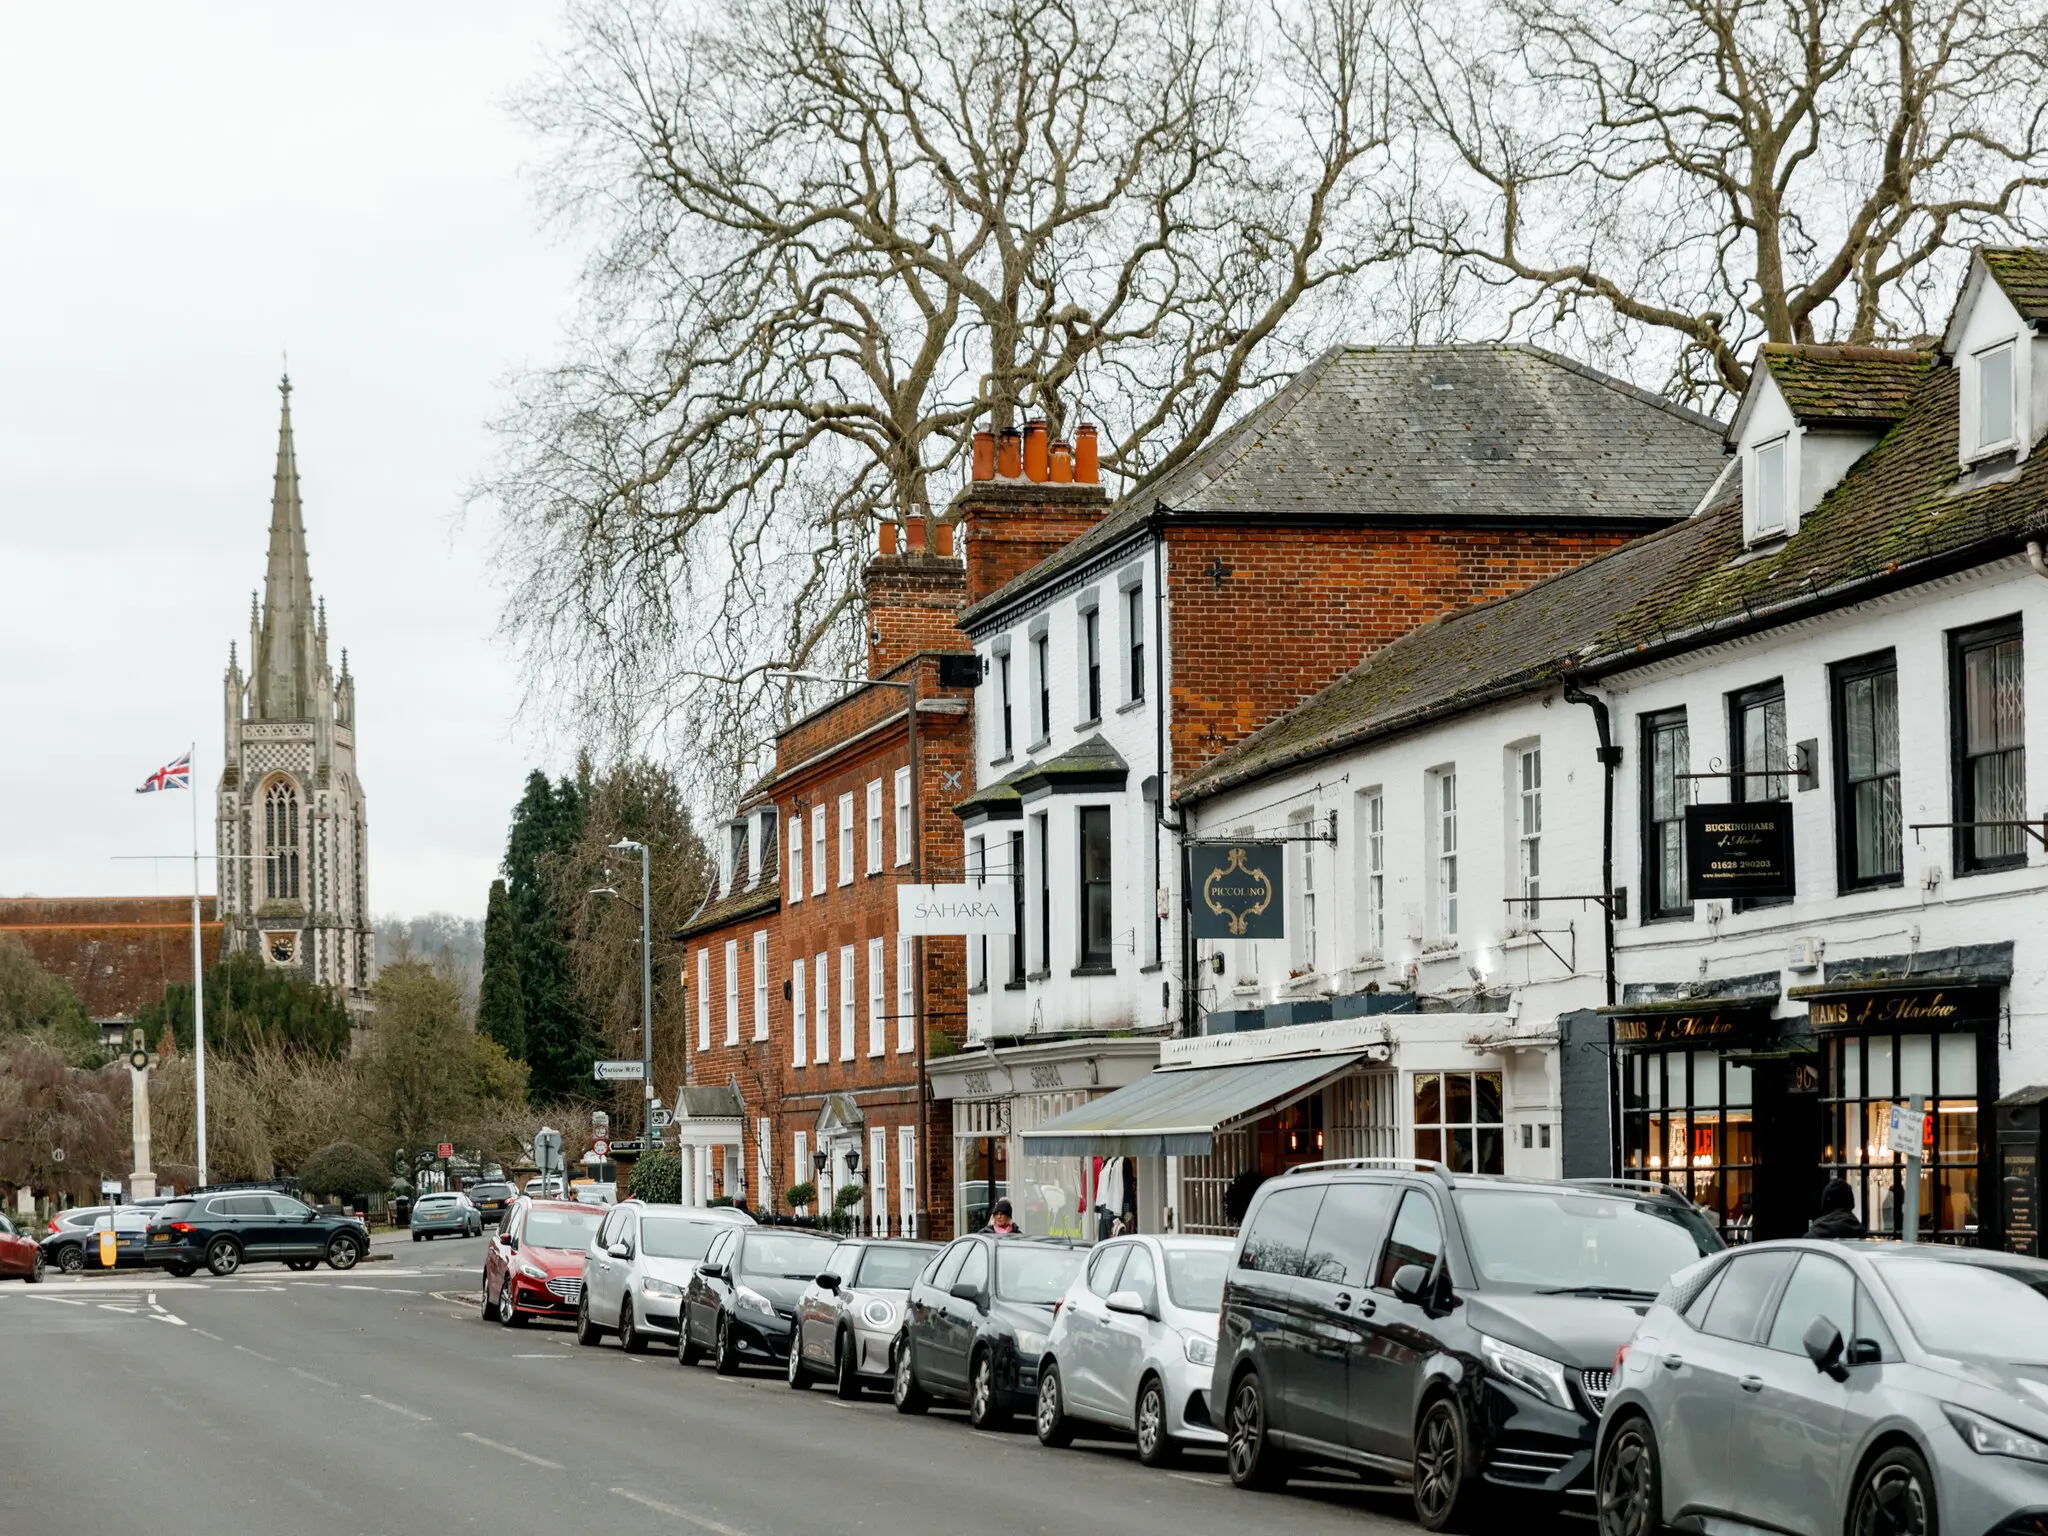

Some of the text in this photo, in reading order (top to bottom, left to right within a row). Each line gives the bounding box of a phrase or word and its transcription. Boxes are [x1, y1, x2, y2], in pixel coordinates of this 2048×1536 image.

[1704, 822, 1775, 832] BUCKINGHAMS
[1717, 834, 1762, 848] of Marlow
[1711, 860, 1771, 869] 01628 290203
[1211, 887, 1265, 896] PICCOLINO
[914, 902, 1000, 918] SAHARA
[1856, 999, 1874, 1025] of
[1878, 993, 1958, 1020] Marlow
[1655, 1017, 1668, 1041] of
[1670, 1016, 1734, 1038] Marlow
[567, 1295, 577, 1303] EK
